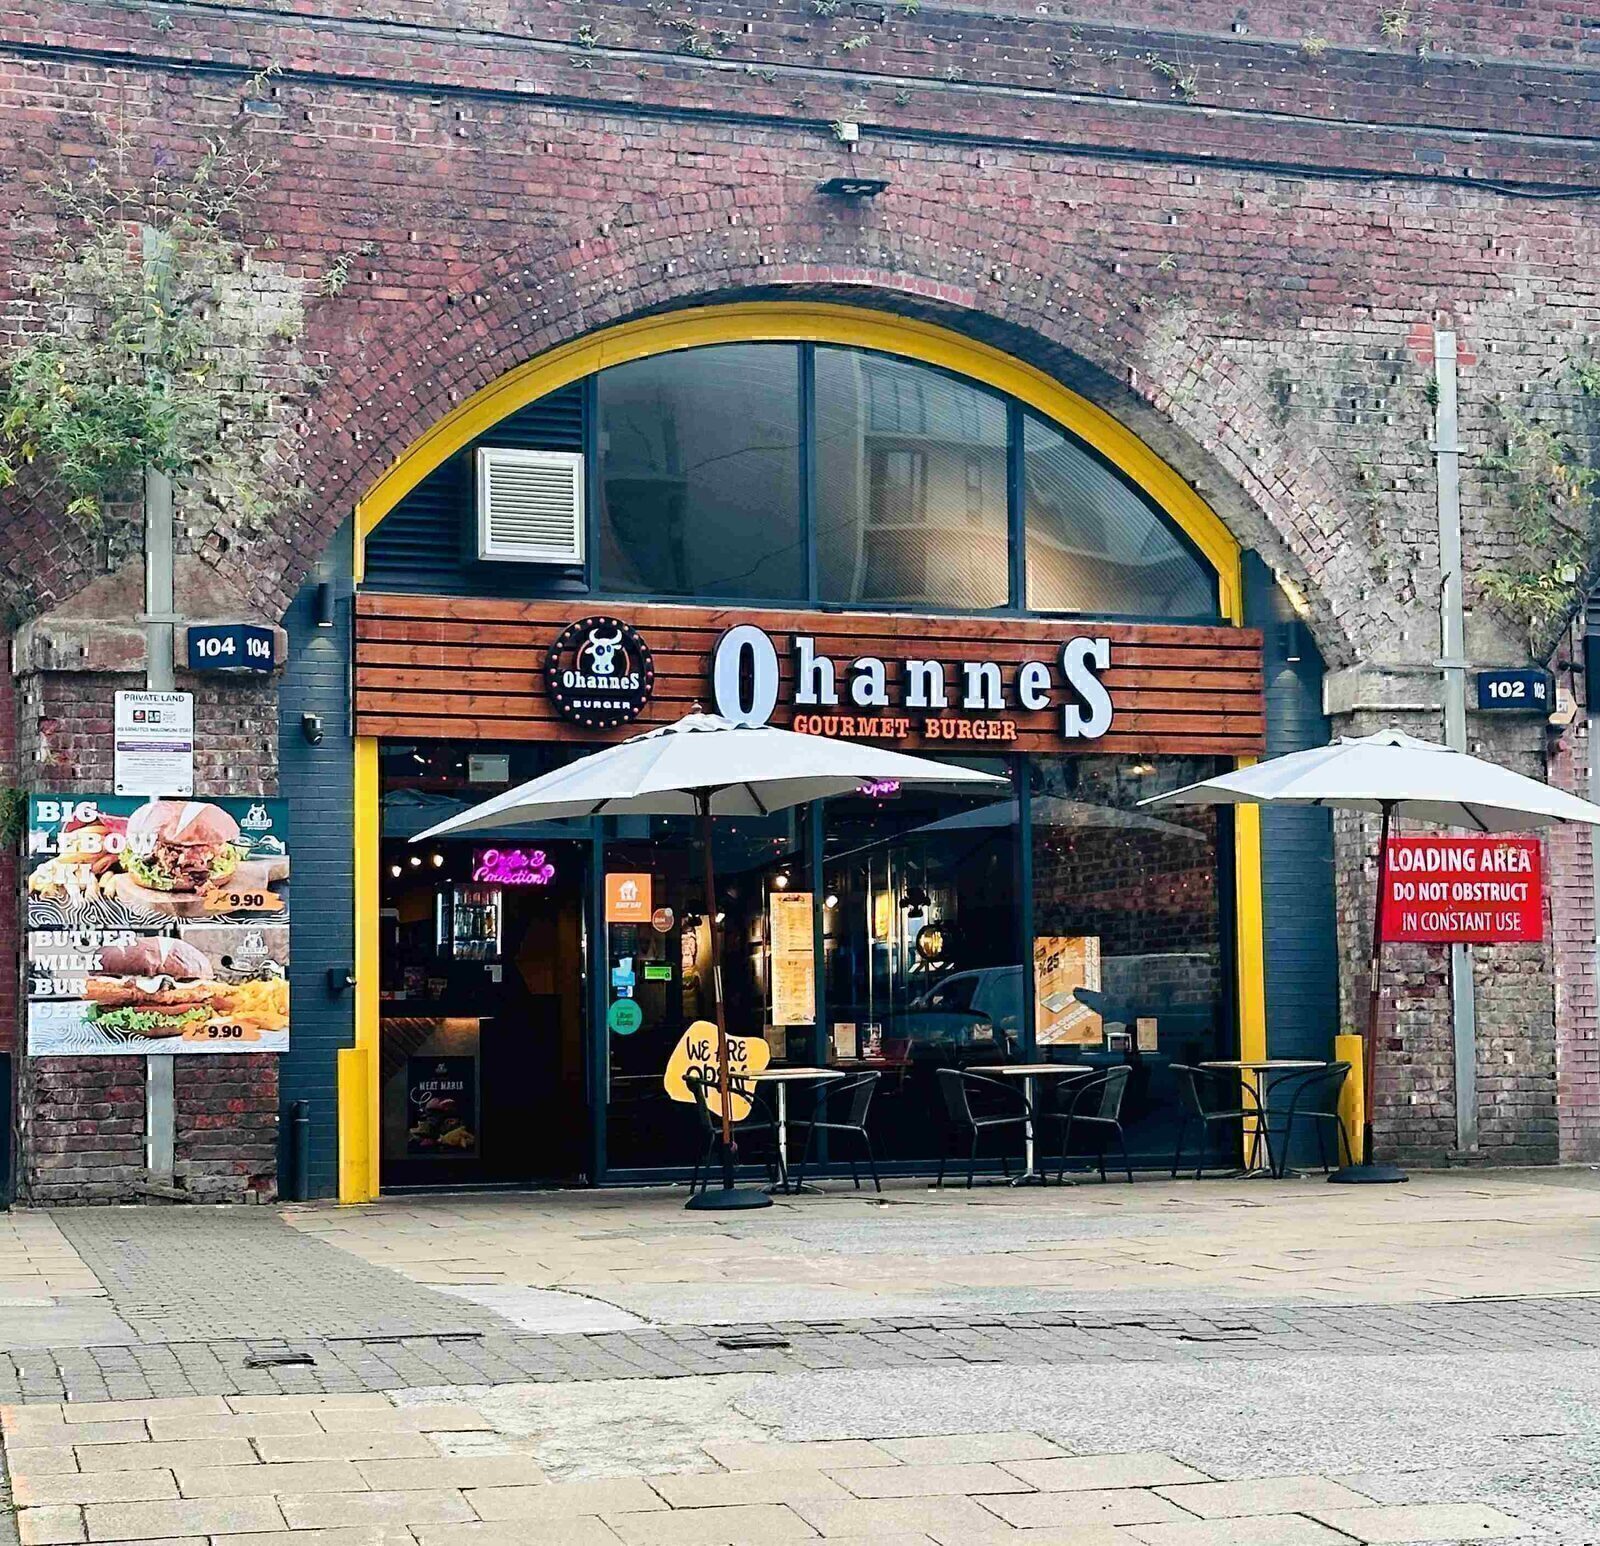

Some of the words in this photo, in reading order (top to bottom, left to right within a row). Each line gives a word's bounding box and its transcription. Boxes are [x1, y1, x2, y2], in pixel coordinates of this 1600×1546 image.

[196, 637, 236, 657] 104
[246, 637, 271, 659] 104
[123, 693, 159, 702] PRIVATE
[161, 694, 185, 703] LAND
[1488, 681, 1526, 698] 102
[1533, 682, 1546, 699] 102
[572, 700, 631, 709] BURGER
[793, 715, 910, 738] GOURMET
[925, 718, 1018, 740] BURGER
[36, 801, 98, 823] BIG
[36, 832, 158, 855] LEBOW
[1388, 847, 1476, 872] LOADING
[1480, 848, 1532, 873] AREA
[229, 894, 264, 907] 9.90
[1393, 882, 1415, 900] DO
[1418, 882, 1449, 901] NOT
[1451, 882, 1528, 901] OBSTRUCT
[1402, 912, 1417, 931] IN
[1420, 911, 1492, 931] CONSTANT
[1495, 911, 1522, 931] USE
[34, 930, 138, 947] BUTTER
[34, 954, 104, 971] MILK
[34, 978, 89, 995] BUR
[208, 1025, 243, 1038] 9.90
[686, 1036, 711, 1062] WE
